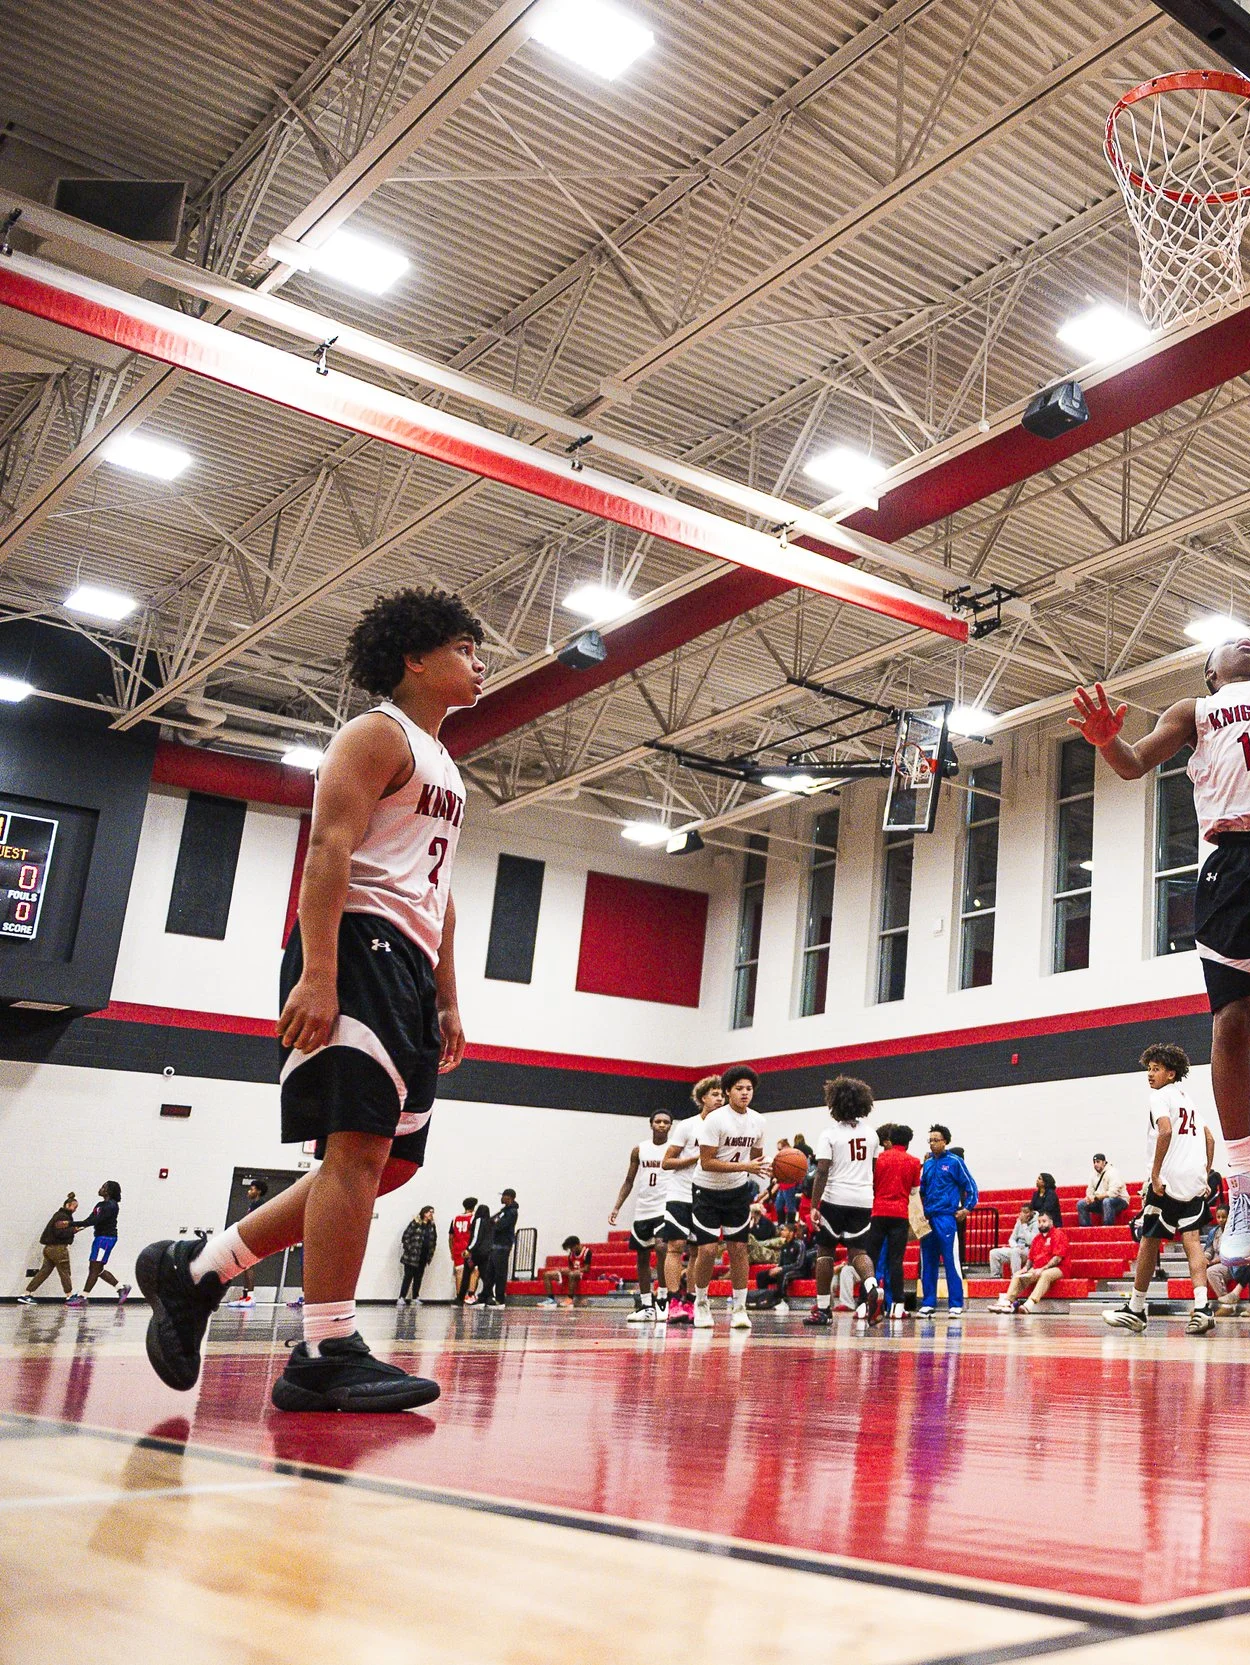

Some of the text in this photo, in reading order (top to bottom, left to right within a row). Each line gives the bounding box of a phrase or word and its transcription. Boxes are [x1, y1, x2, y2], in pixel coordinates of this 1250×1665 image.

[0, 845, 28, 861] UEST
[427, 836, 449, 889] 2
[18, 865, 38, 889] 0
[7, 889, 38, 901] FOULS
[15, 901, 31, 922] 0
[2, 922, 33, 935] SCORE
[1178, 1107, 1196, 1136] 24
[730, 1152, 741, 1162] 4
[848, 1138, 867, 1161] 15
[649, 1172, 657, 1186] 0
